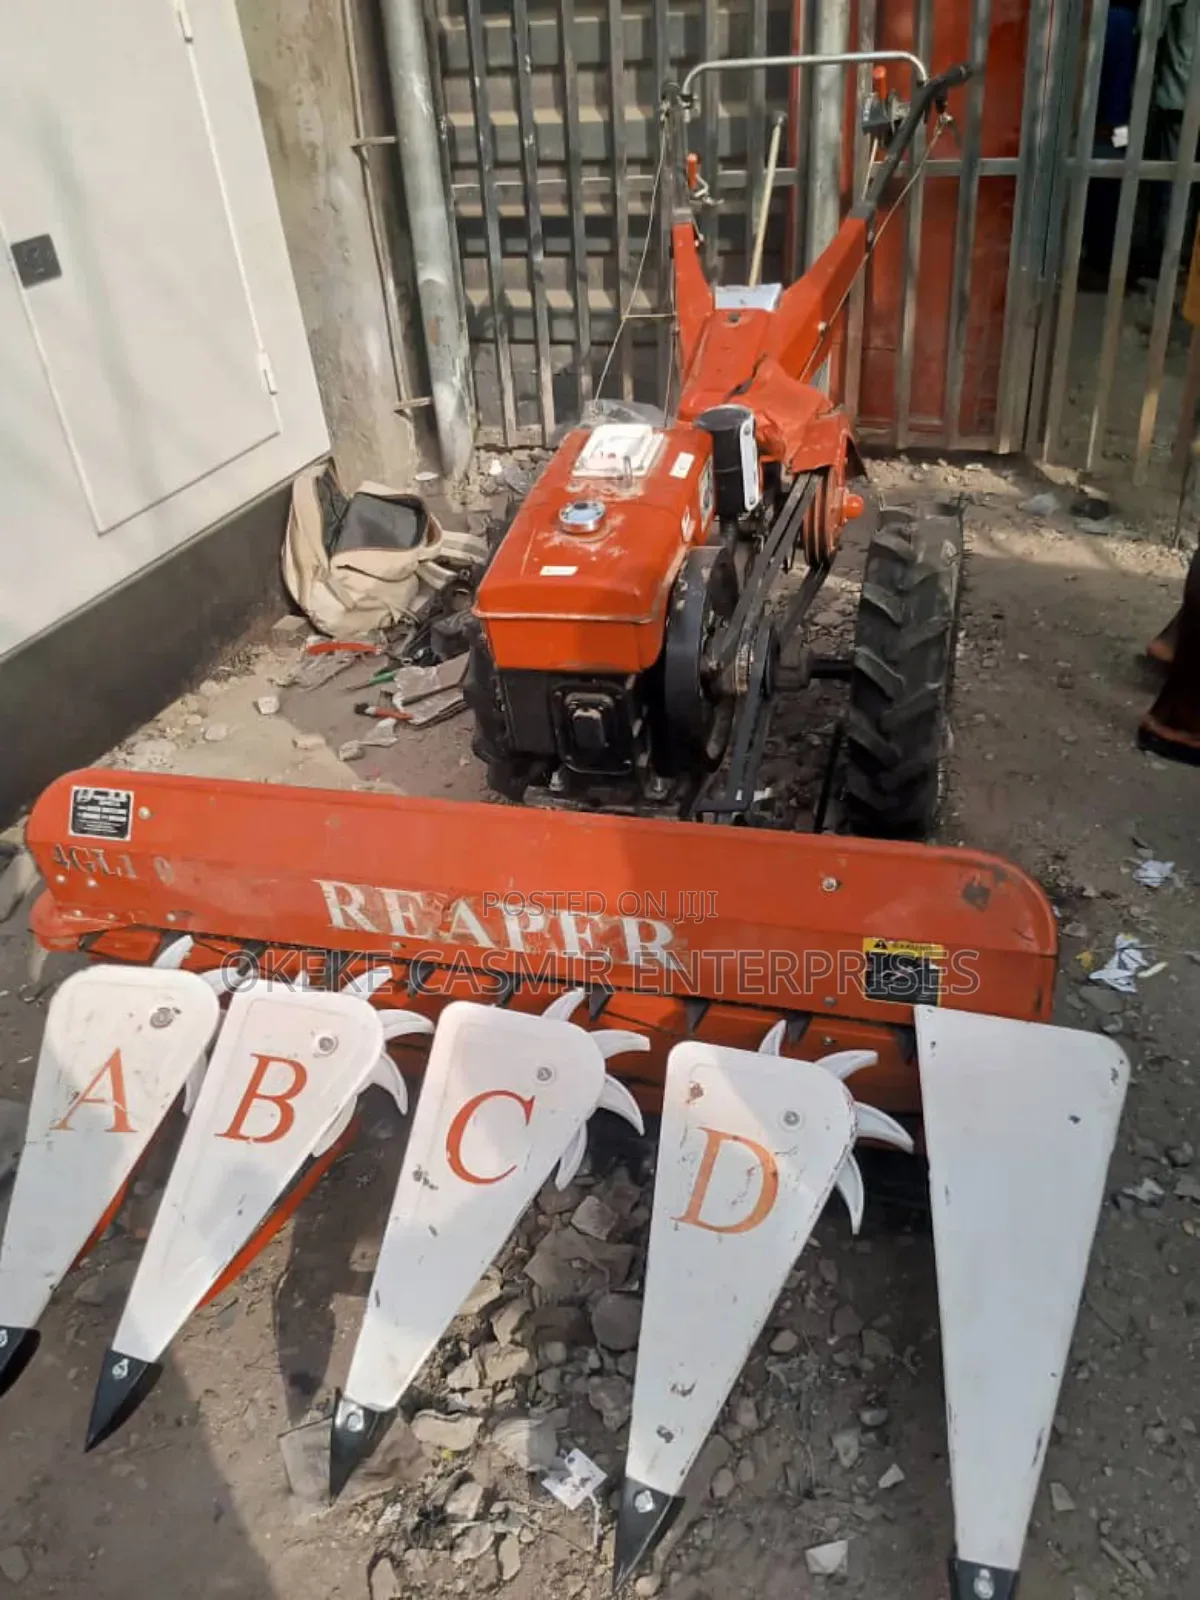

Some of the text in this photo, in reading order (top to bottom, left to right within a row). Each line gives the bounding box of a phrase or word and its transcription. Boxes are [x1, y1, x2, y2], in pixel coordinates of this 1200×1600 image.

[312, 879, 687, 972] REAPER
[49, 1048, 138, 1133] A
[214, 1053, 309, 1144] B
[445, 1090, 536, 1185] C
[670, 1126, 779, 1234] D
